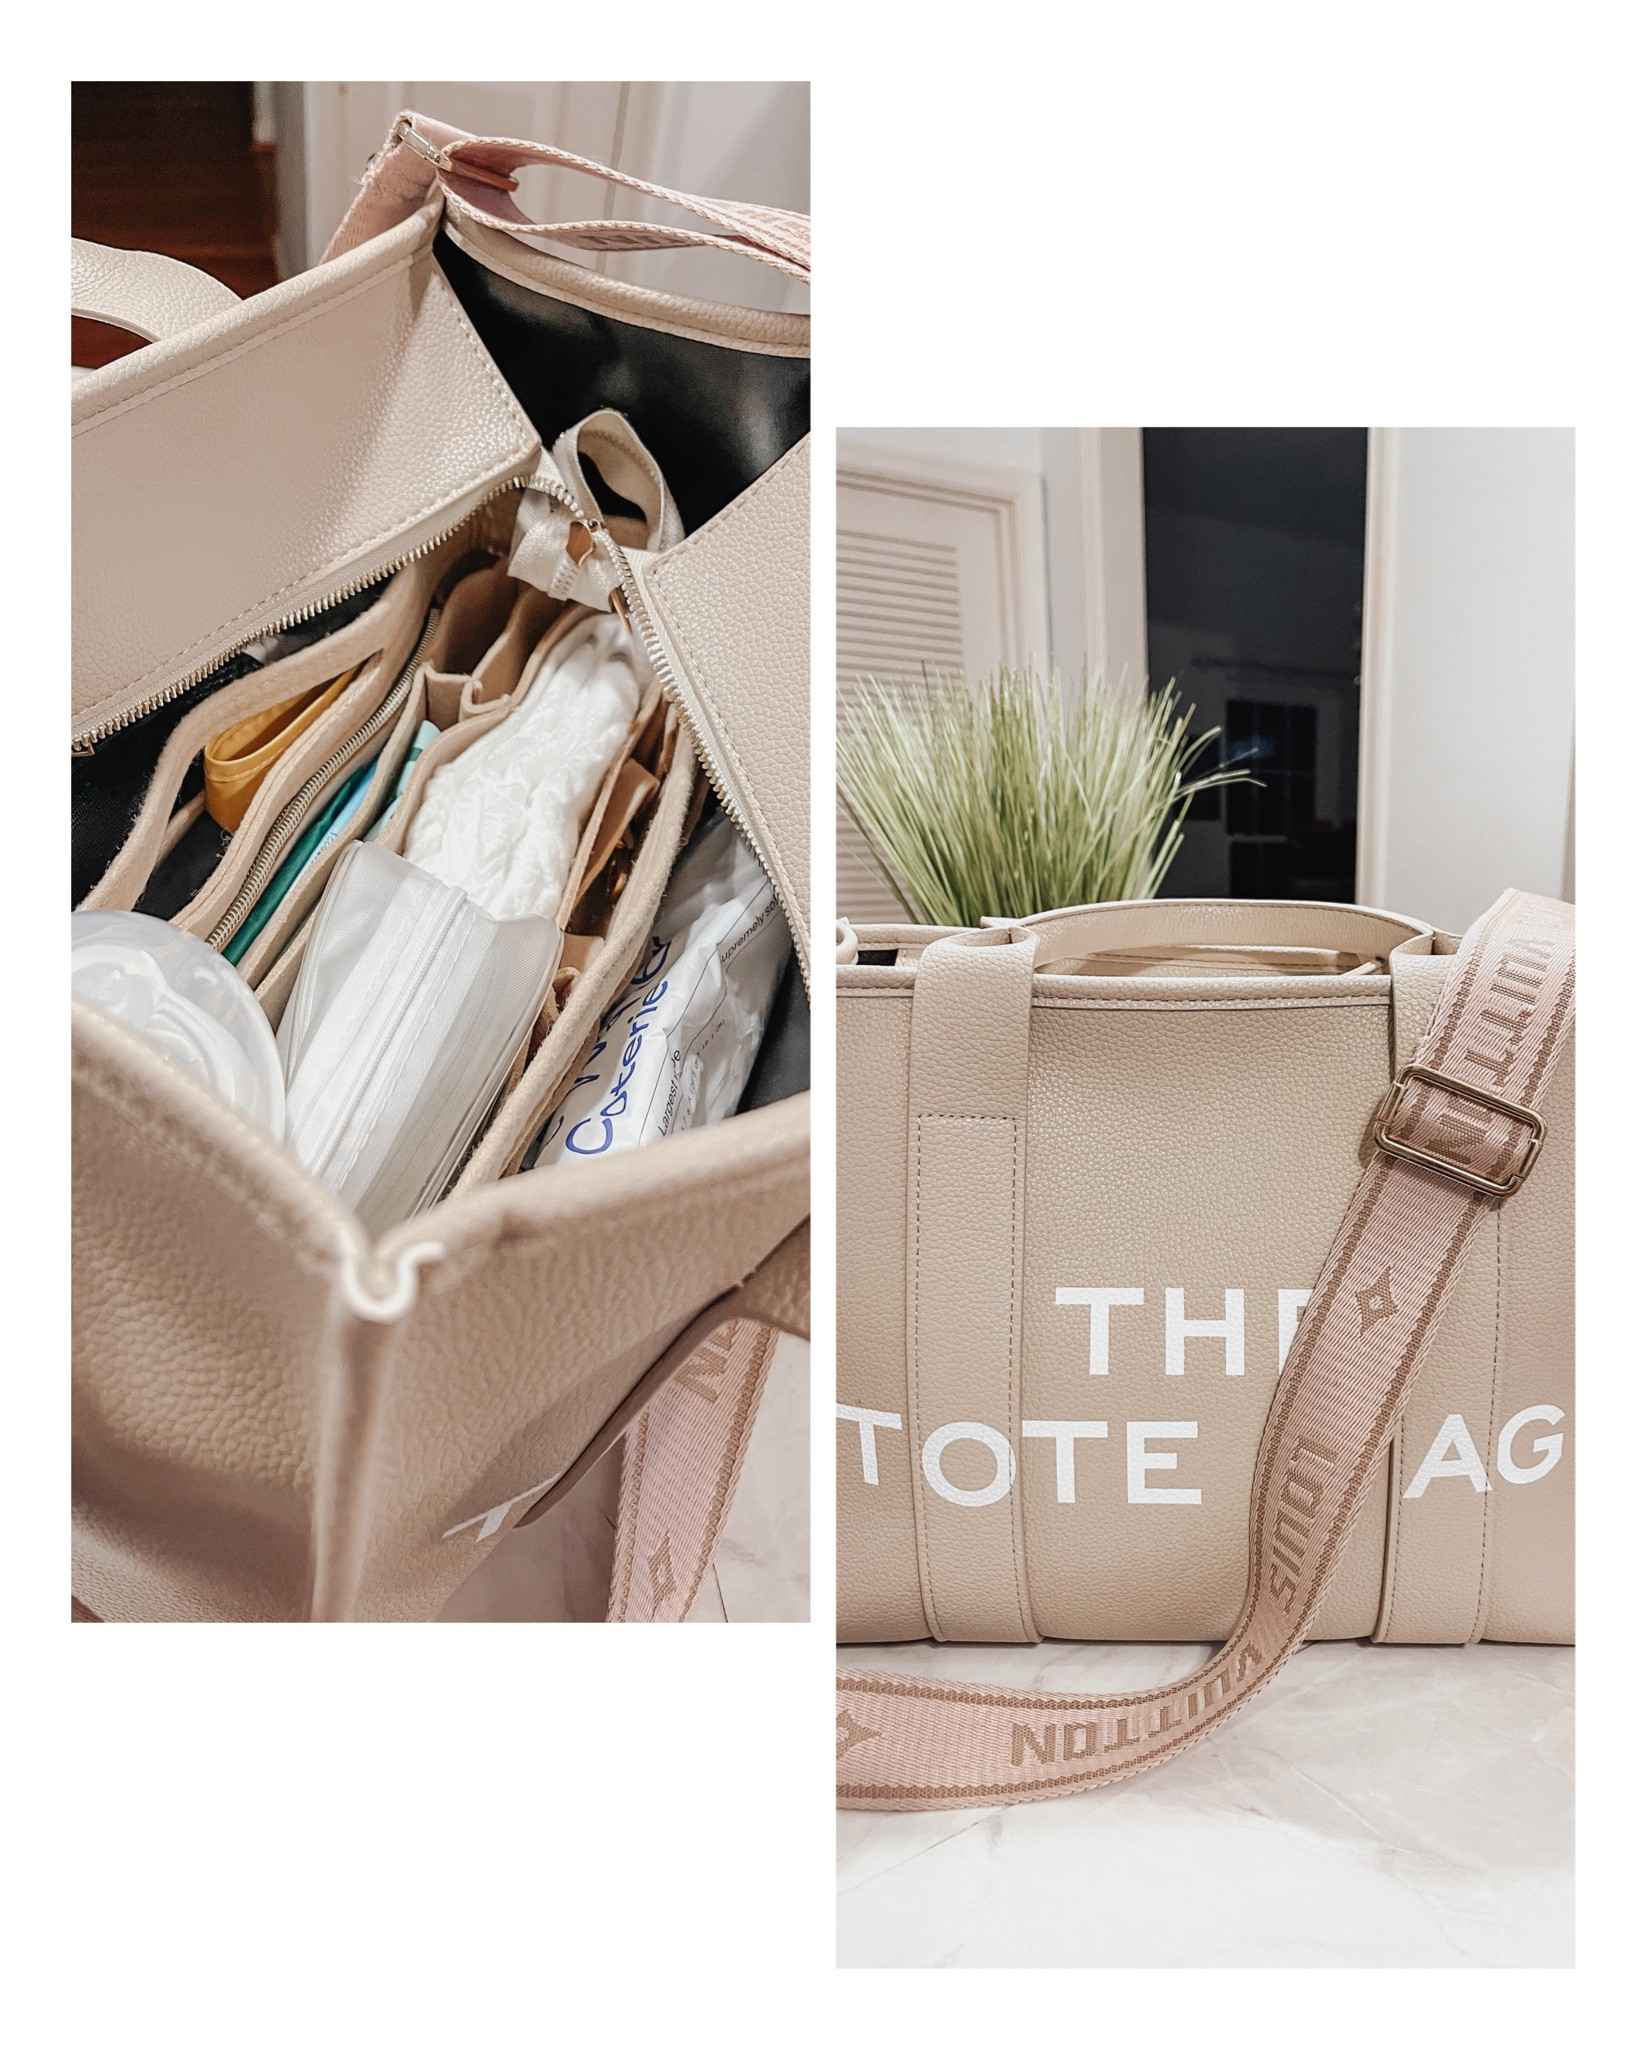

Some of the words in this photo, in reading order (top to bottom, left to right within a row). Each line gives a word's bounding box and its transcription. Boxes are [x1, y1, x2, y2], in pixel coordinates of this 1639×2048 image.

[721, 913, 764, 962] upremely
[566, 980, 669, 1155] Coterie
[658, 1080, 678, 1137] Largest
[836, 1402, 1203, 1507] TOTE
[1403, 1404, 1566, 1498] AG
[1269, 1434, 1339, 1615] LOUIS
[1011, 1641, 1263, 1766] VUITTON
